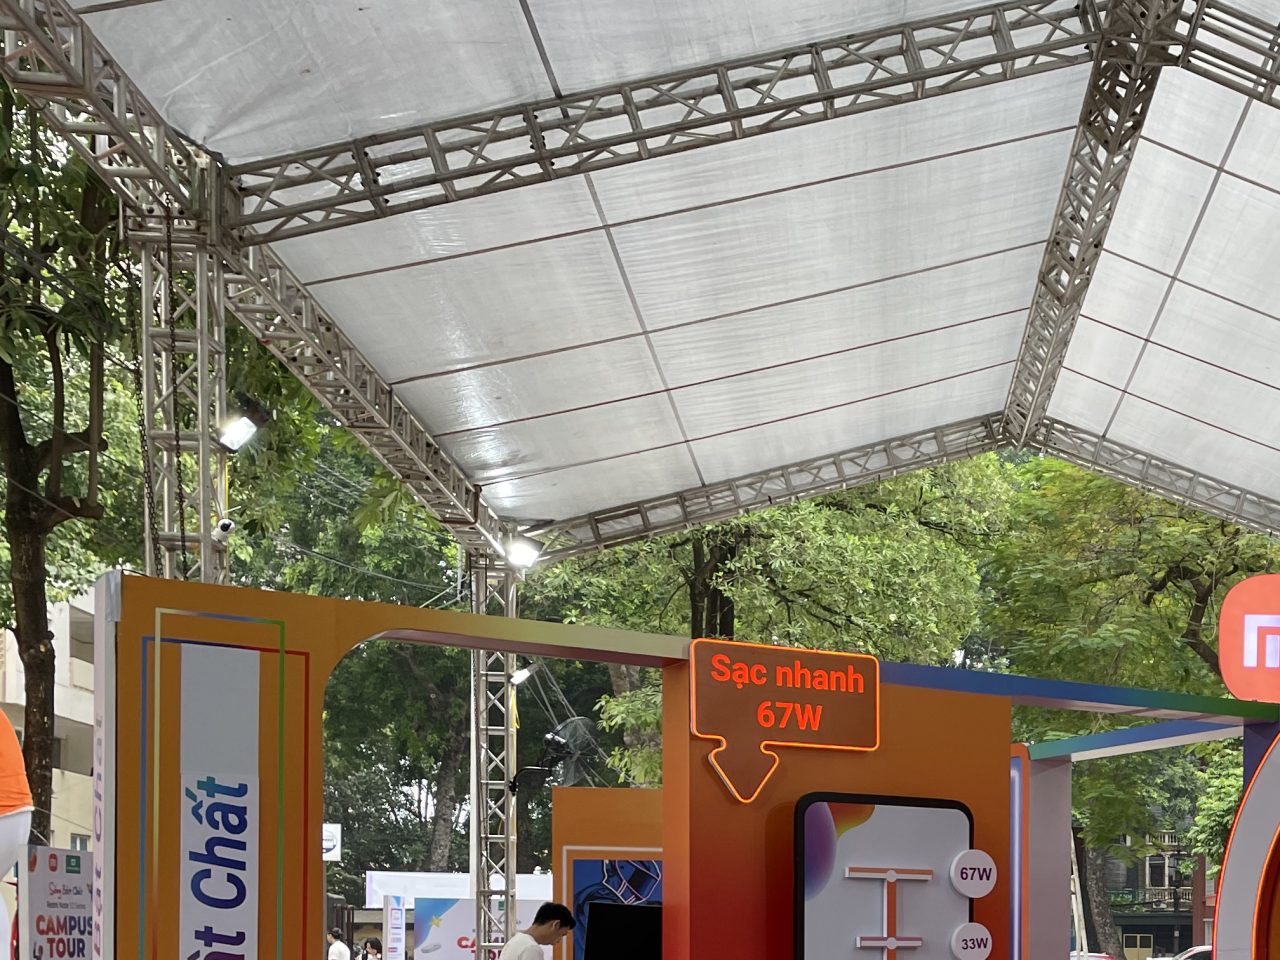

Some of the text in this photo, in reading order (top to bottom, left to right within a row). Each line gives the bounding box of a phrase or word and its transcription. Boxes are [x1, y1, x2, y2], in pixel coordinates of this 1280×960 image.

[710, 653, 864, 693] Sạc nhanh
[756, 700, 823, 731] 67W
[185, 776, 248, 910] Chất
[959, 867, 992, 881] 67W
[46, 937, 86, 958] TOUR
[961, 937, 989, 950] 33W
